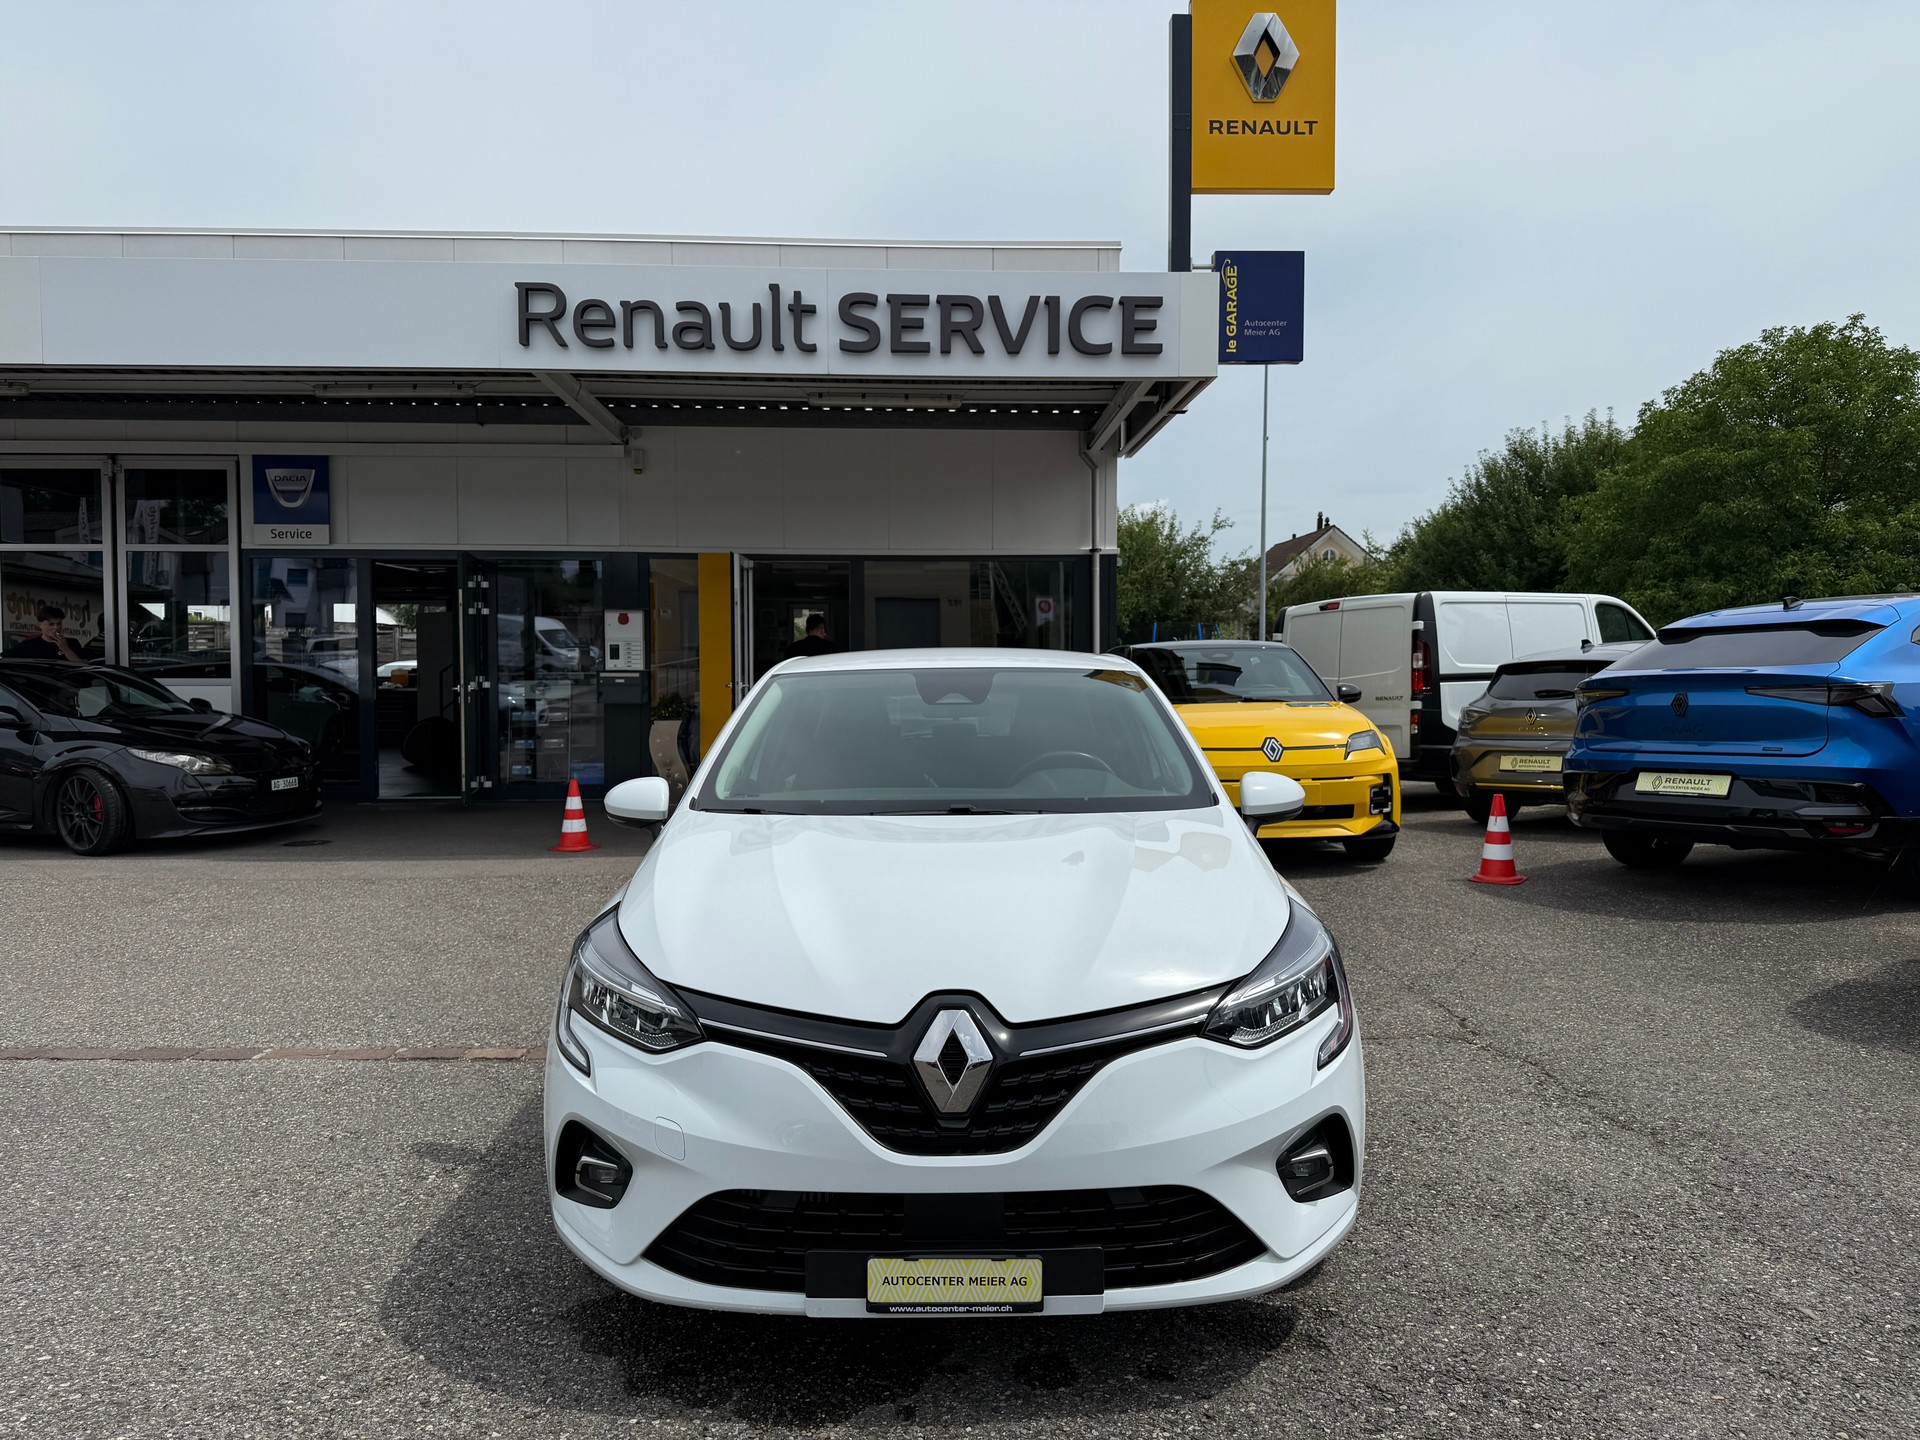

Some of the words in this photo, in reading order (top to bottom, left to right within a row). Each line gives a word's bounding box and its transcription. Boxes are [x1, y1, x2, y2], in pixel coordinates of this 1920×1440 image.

[1208, 119, 1318, 136] RENAULT
[1225, 265, 1238, 337] GARAGE
[514, 282, 818, 353] Renault
[838, 291, 1164, 356] SERVICE
[1244, 319, 1288, 327] Autocenter
[1244, 328, 1267, 336] Meier
[1268, 328, 1281, 336] AG
[1225, 339, 1237, 353] le
[270, 528, 313, 539] Service
[1664, 776, 1712, 786] RENAULT
[882, 1275, 964, 1287] AUTOCENTER
[968, 1275, 1006, 1287] MEIER
[1010, 1275, 1028, 1287] AG
[889, 1304, 1013, 1313] www.autocenter-meier.ch
